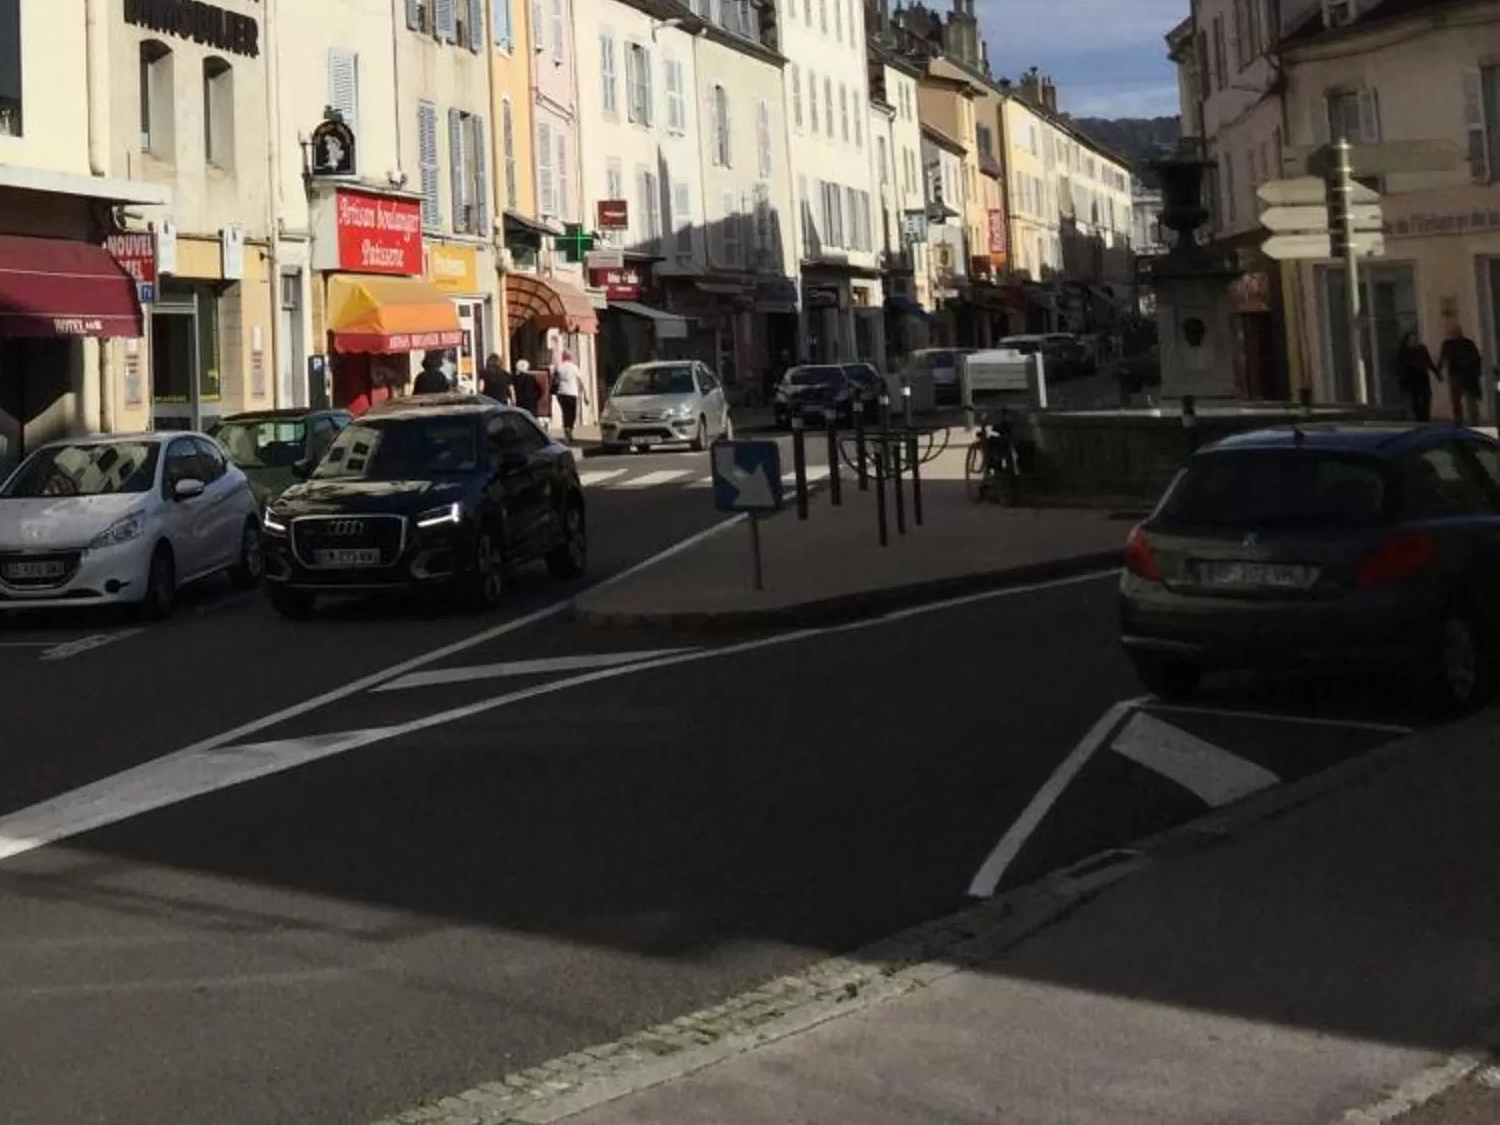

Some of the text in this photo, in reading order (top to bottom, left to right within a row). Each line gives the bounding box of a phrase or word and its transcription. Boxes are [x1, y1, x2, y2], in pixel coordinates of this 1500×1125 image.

[338, 197, 376, 227] Artisan
[106, 234, 153, 256] NOUVEL
[53, 318, 87, 334] HOTEL
